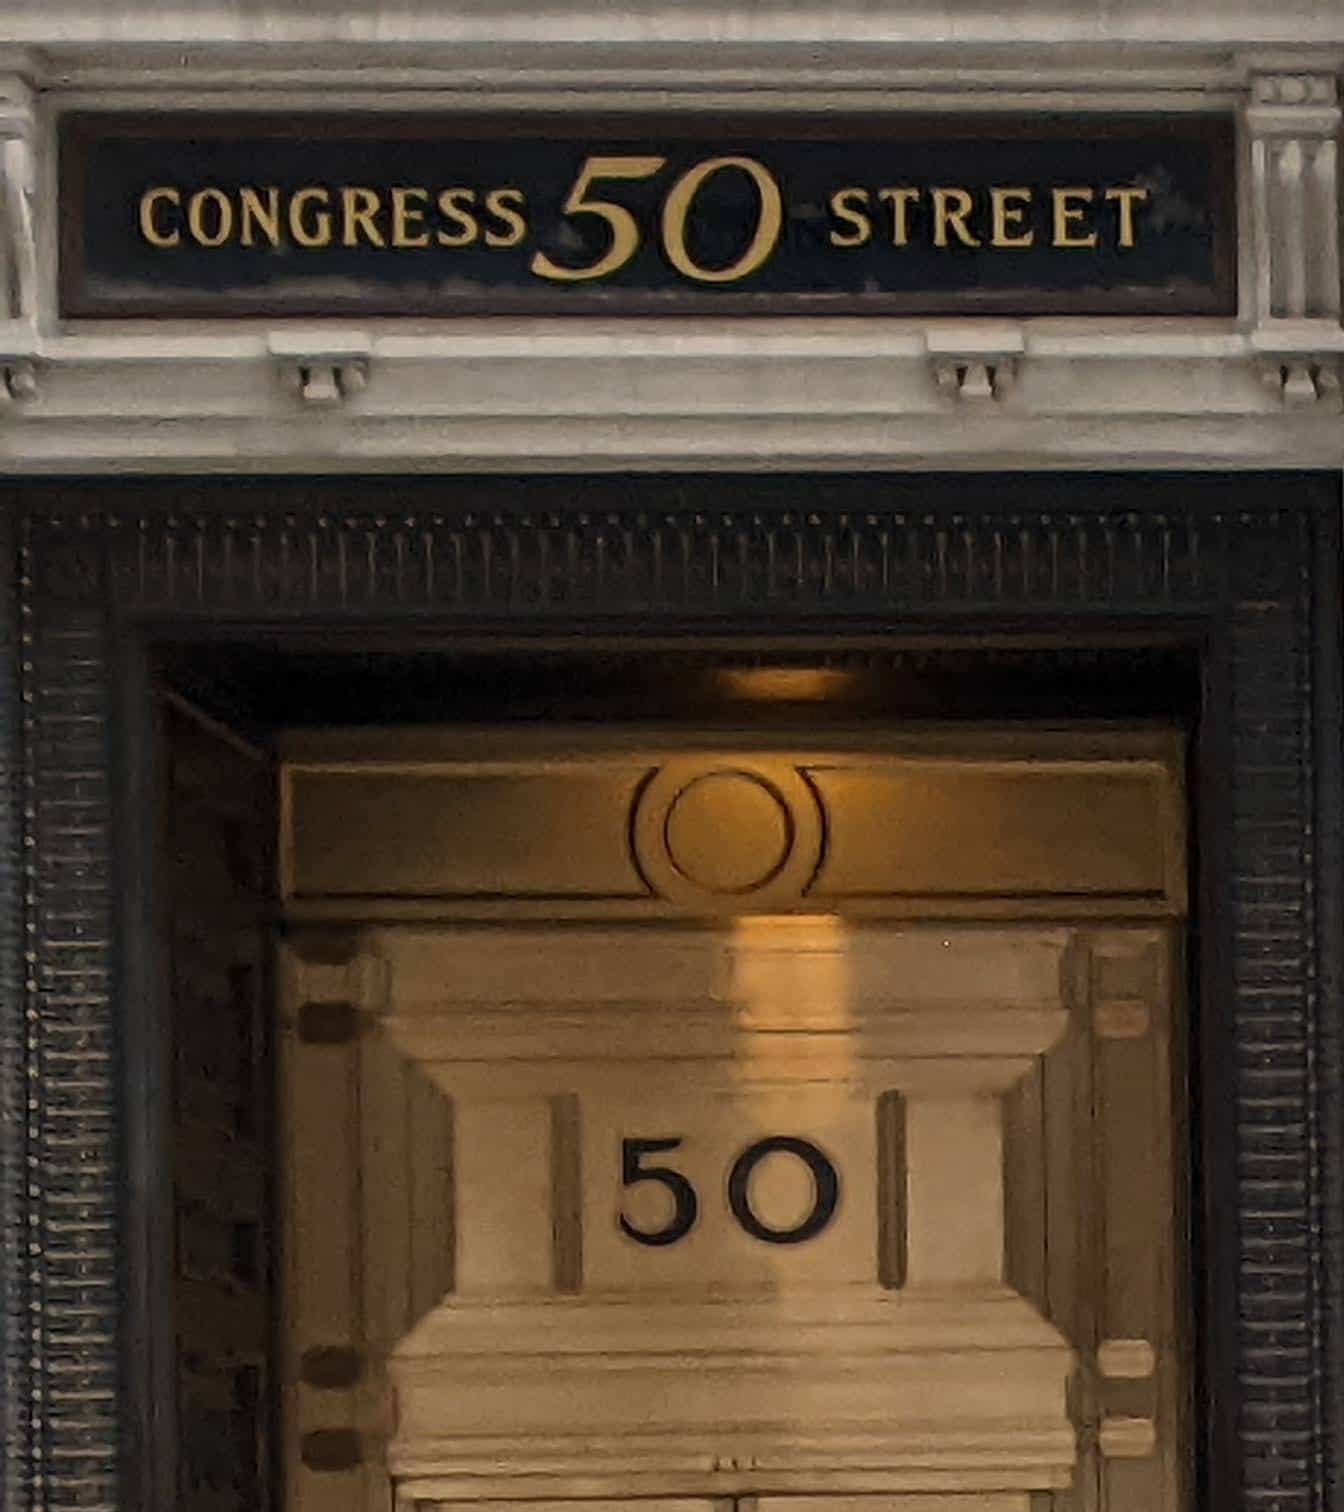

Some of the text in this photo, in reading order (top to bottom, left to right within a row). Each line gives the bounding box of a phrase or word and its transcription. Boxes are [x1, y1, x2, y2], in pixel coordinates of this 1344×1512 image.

[138, 156, 1150, 283] CONGRESS 50 STREET
[619, 1136, 838, 1246] 50
